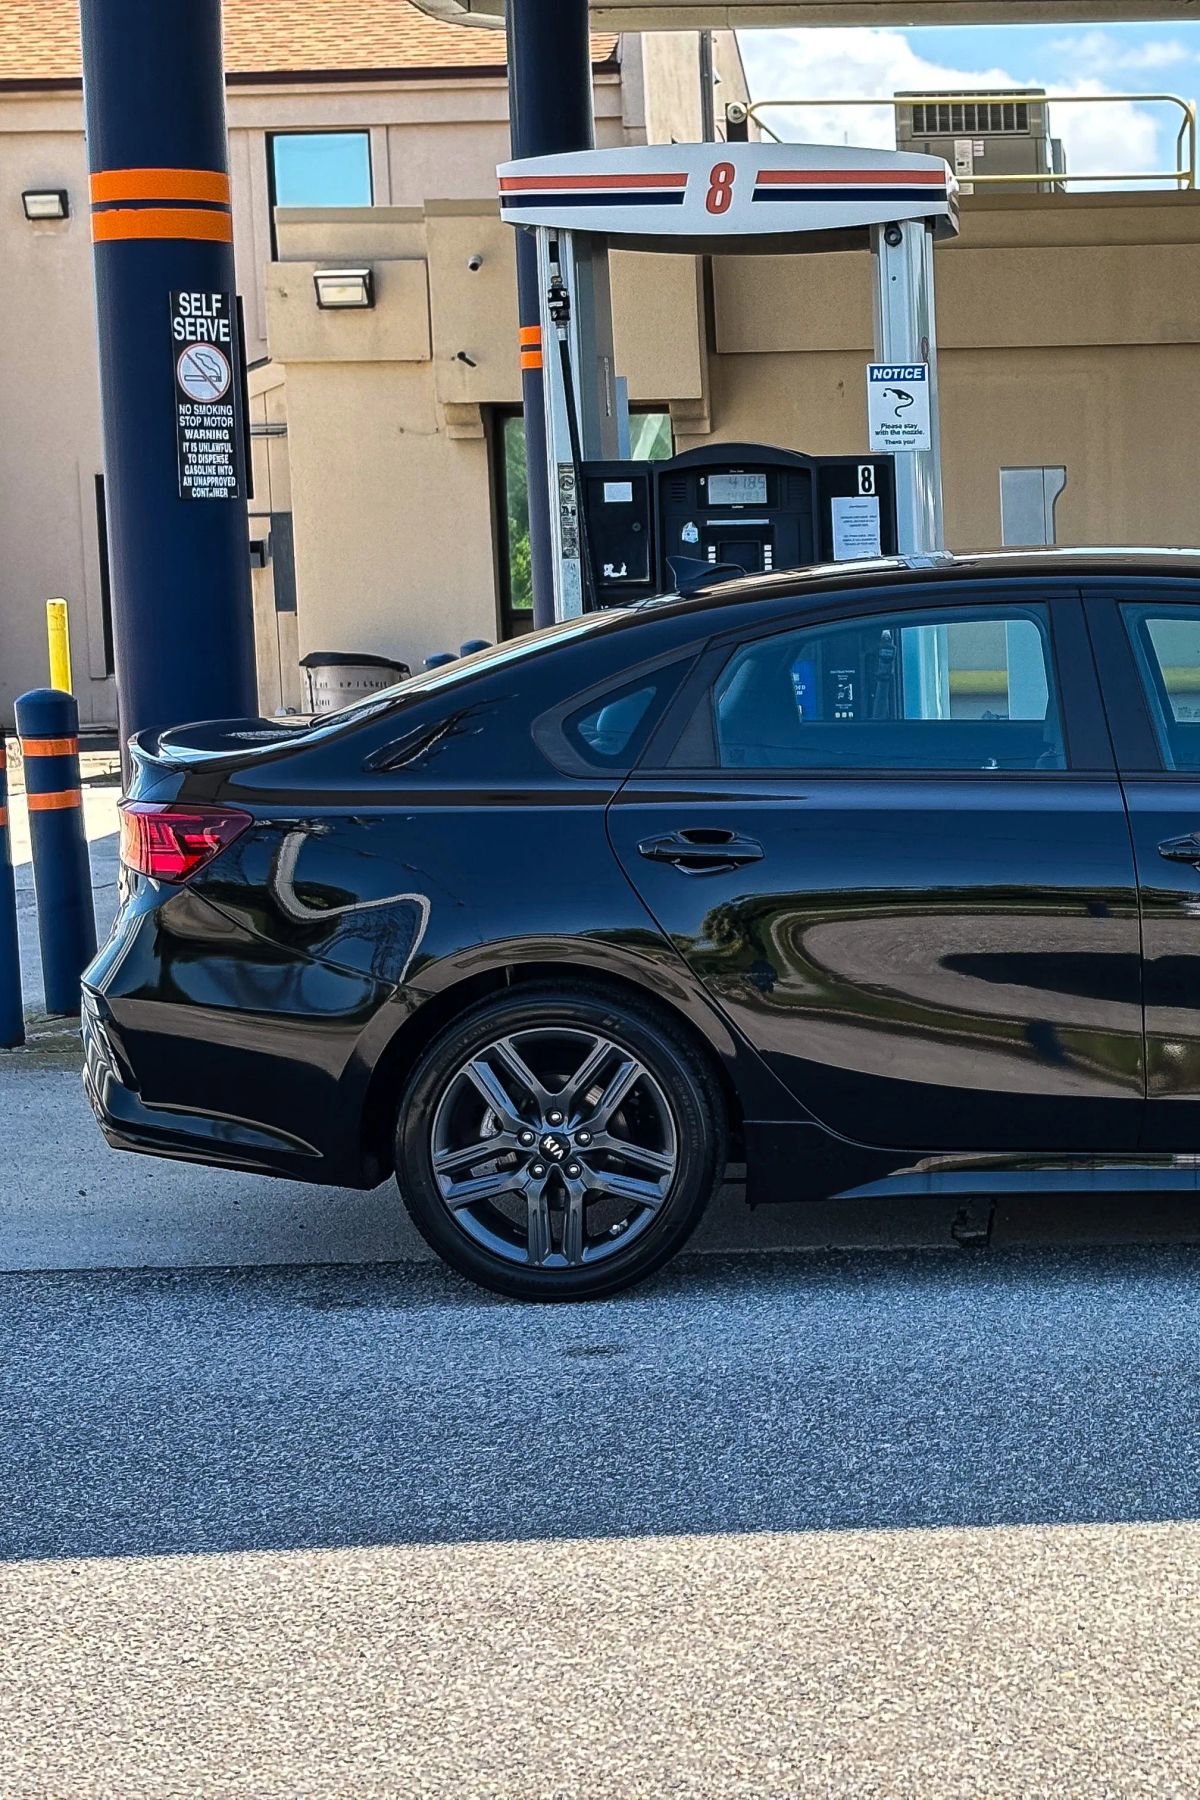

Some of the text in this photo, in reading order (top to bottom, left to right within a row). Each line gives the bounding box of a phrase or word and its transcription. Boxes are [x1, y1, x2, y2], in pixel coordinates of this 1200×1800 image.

[706, 162, 735, 214] 8
[179, 292, 222, 317] SELF
[173, 318, 230, 341] SERVE
[873, 368, 922, 379] NOTICE
[179, 404, 233, 416] NO SMOKING
[179, 417, 233, 427] STOP MOTOR
[185, 430, 229, 440] WARNING
[183, 442, 233, 453] IT IS UNLAWFUL
[187, 454, 229, 464] TO DISPENSE
[185, 465, 233, 476] GASOLINE INTO
[183, 476, 236, 487] AN UNAPPROVED
[861, 467, 872, 493] 8
[543, 1136, 564, 1159] KIA
